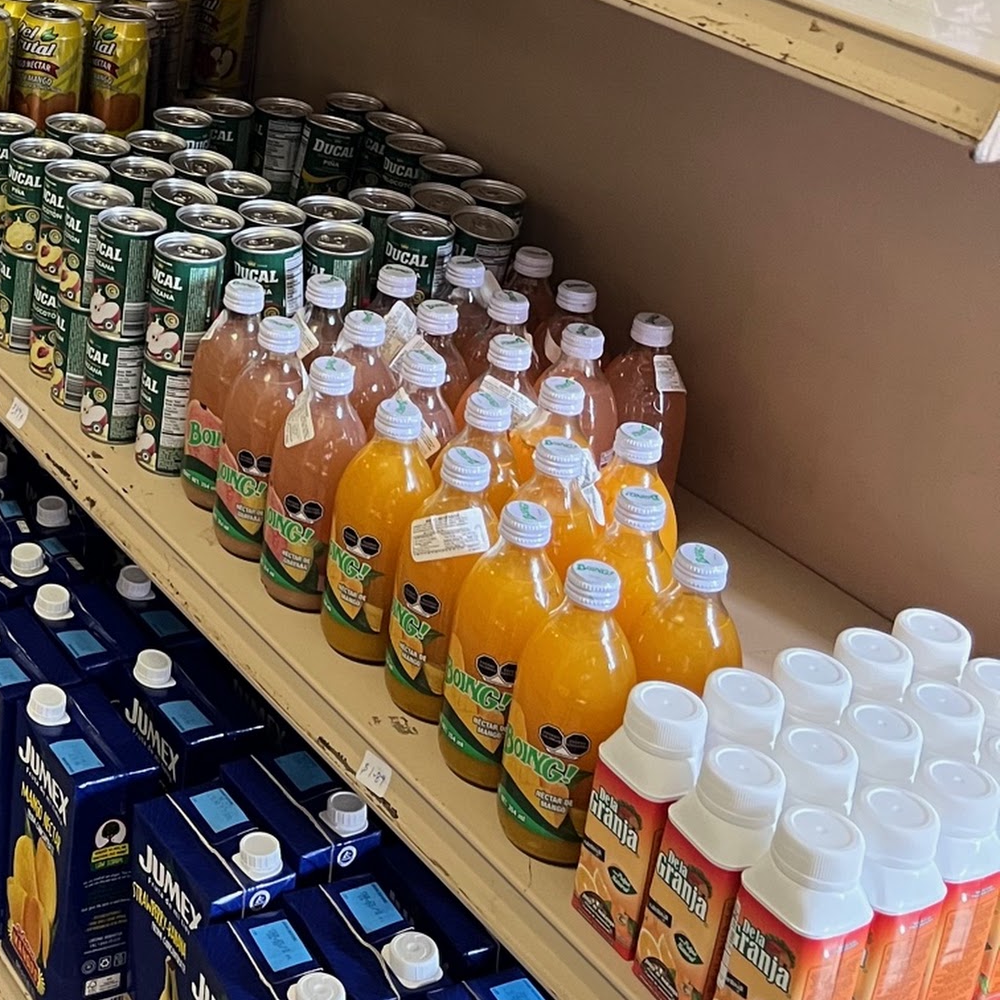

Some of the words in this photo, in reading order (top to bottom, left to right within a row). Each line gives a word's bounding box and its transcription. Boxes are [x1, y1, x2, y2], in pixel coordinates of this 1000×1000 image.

[313, 138, 354, 158] DUCAL
[385, 241, 430, 268] DUCAL
[234, 260, 279, 284] DUCAL
[445, 656, 513, 711] BOING!
[125, 697, 179, 783] JUMEX
[504, 723, 580, 786] BOING!
[18, 736, 69, 827] JUMEX
[564, 798, 574, 807] DE
[600, 786, 610, 806] De
[611, 795, 618, 811] la
[590, 790, 638, 854] Granja
[668, 849, 679, 871] De
[679, 859, 688, 877] la
[656, 851, 707, 922] Granja
[743, 919, 755, 940] De
[755, 927, 765, 946] la
